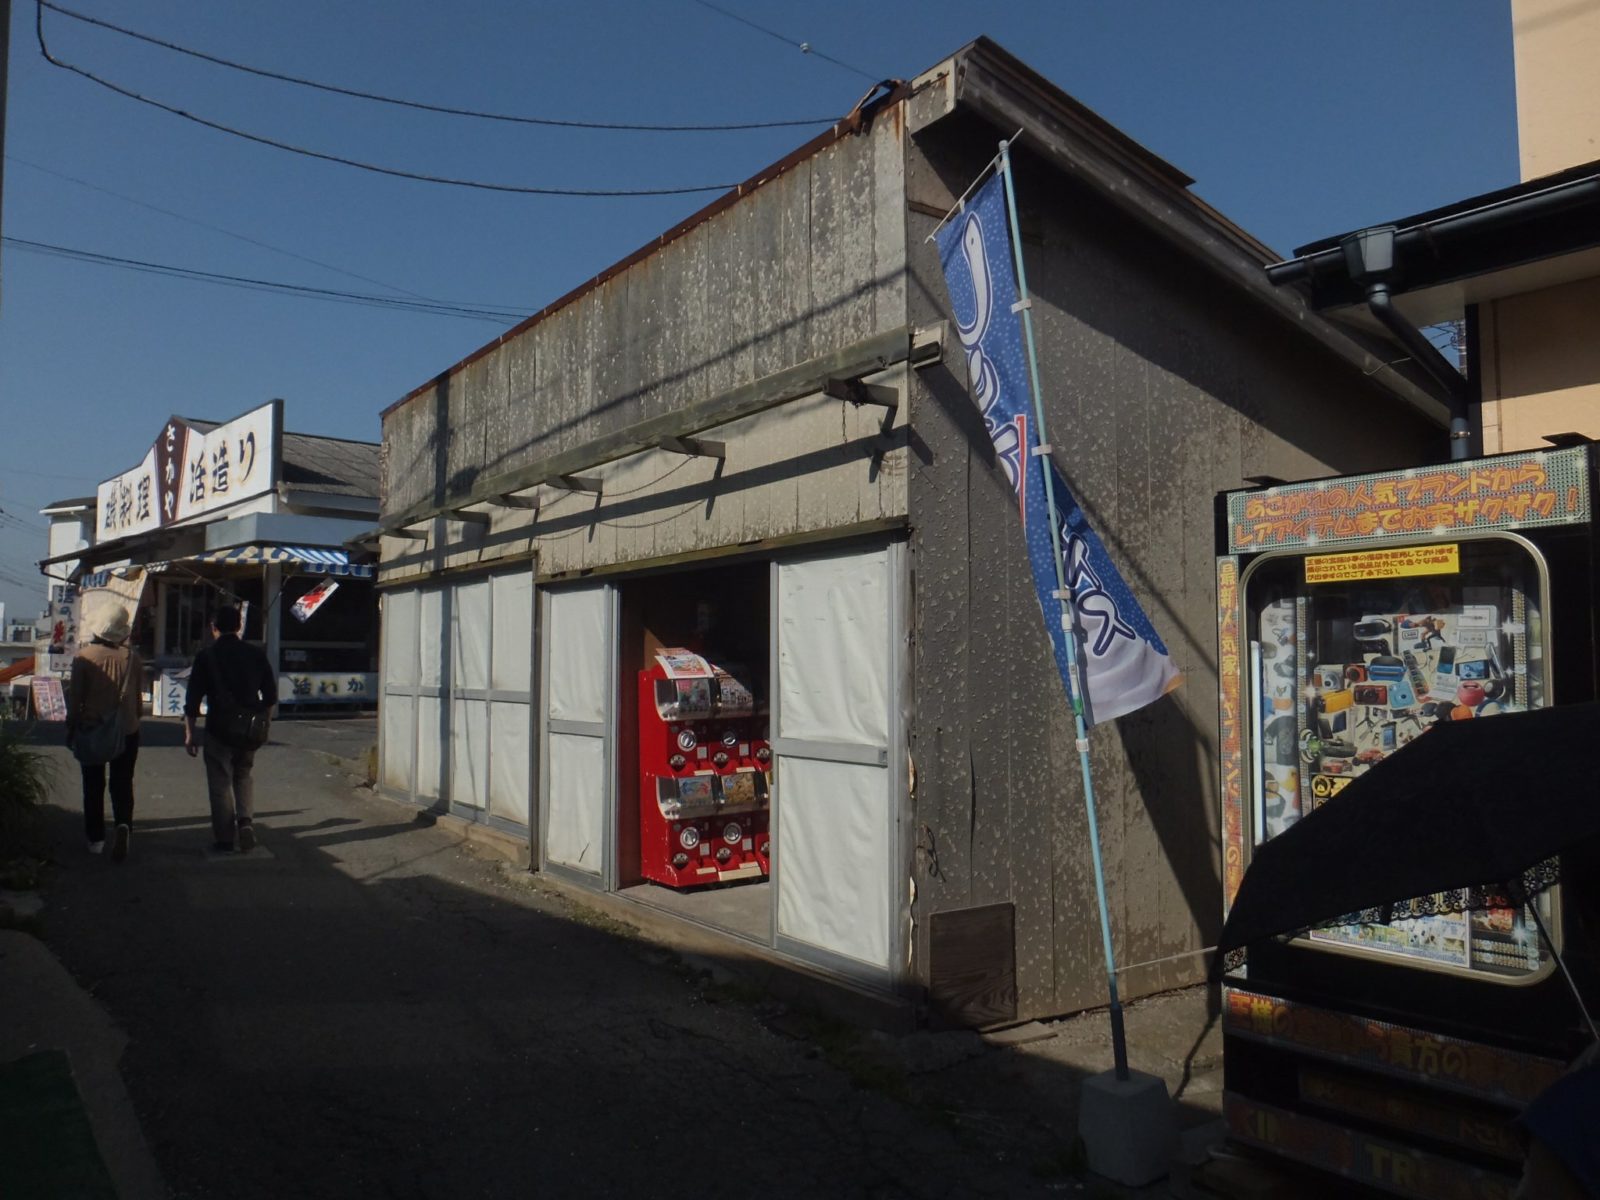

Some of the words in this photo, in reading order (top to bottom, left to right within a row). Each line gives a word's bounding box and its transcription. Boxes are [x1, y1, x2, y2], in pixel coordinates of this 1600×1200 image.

[165, 424, 177, 520] さかや
[190, 431, 256, 504] 活造り
[1245, 465, 1547, 518] あこがれの人気ブランドから
